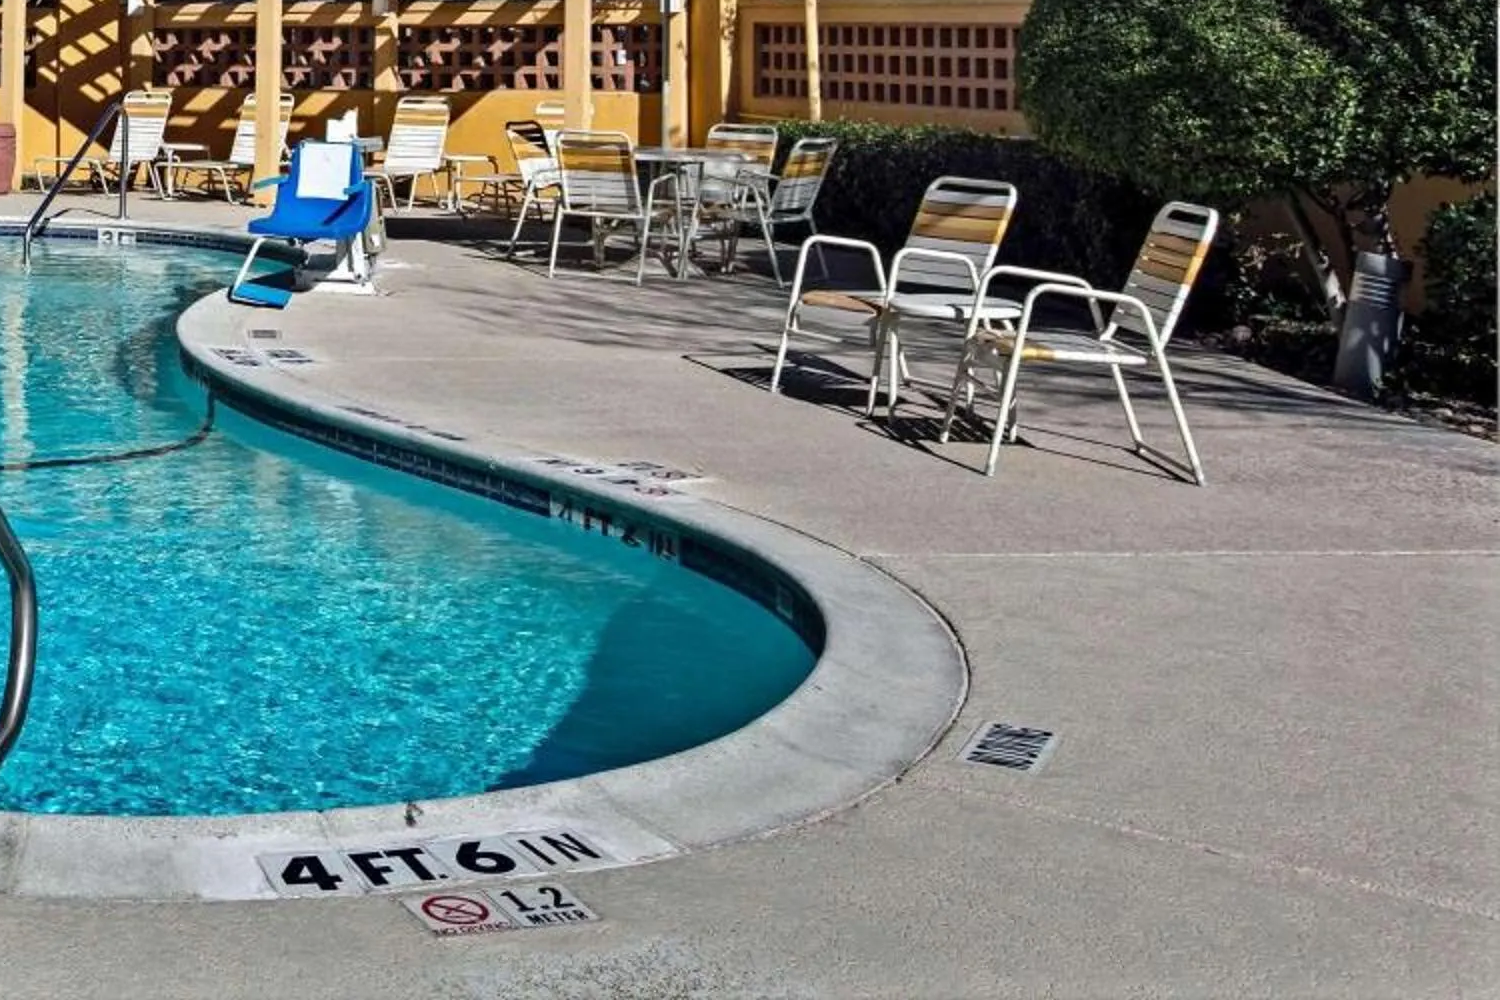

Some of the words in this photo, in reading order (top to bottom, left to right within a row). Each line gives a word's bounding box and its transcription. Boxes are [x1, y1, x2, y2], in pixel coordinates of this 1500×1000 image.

[281, 855, 343, 891] 4
[347, 847, 448, 885] FT.
[456, 841, 516, 875] 6
[518, 832, 601, 866] IN
[501, 887, 575, 912] 1.2
